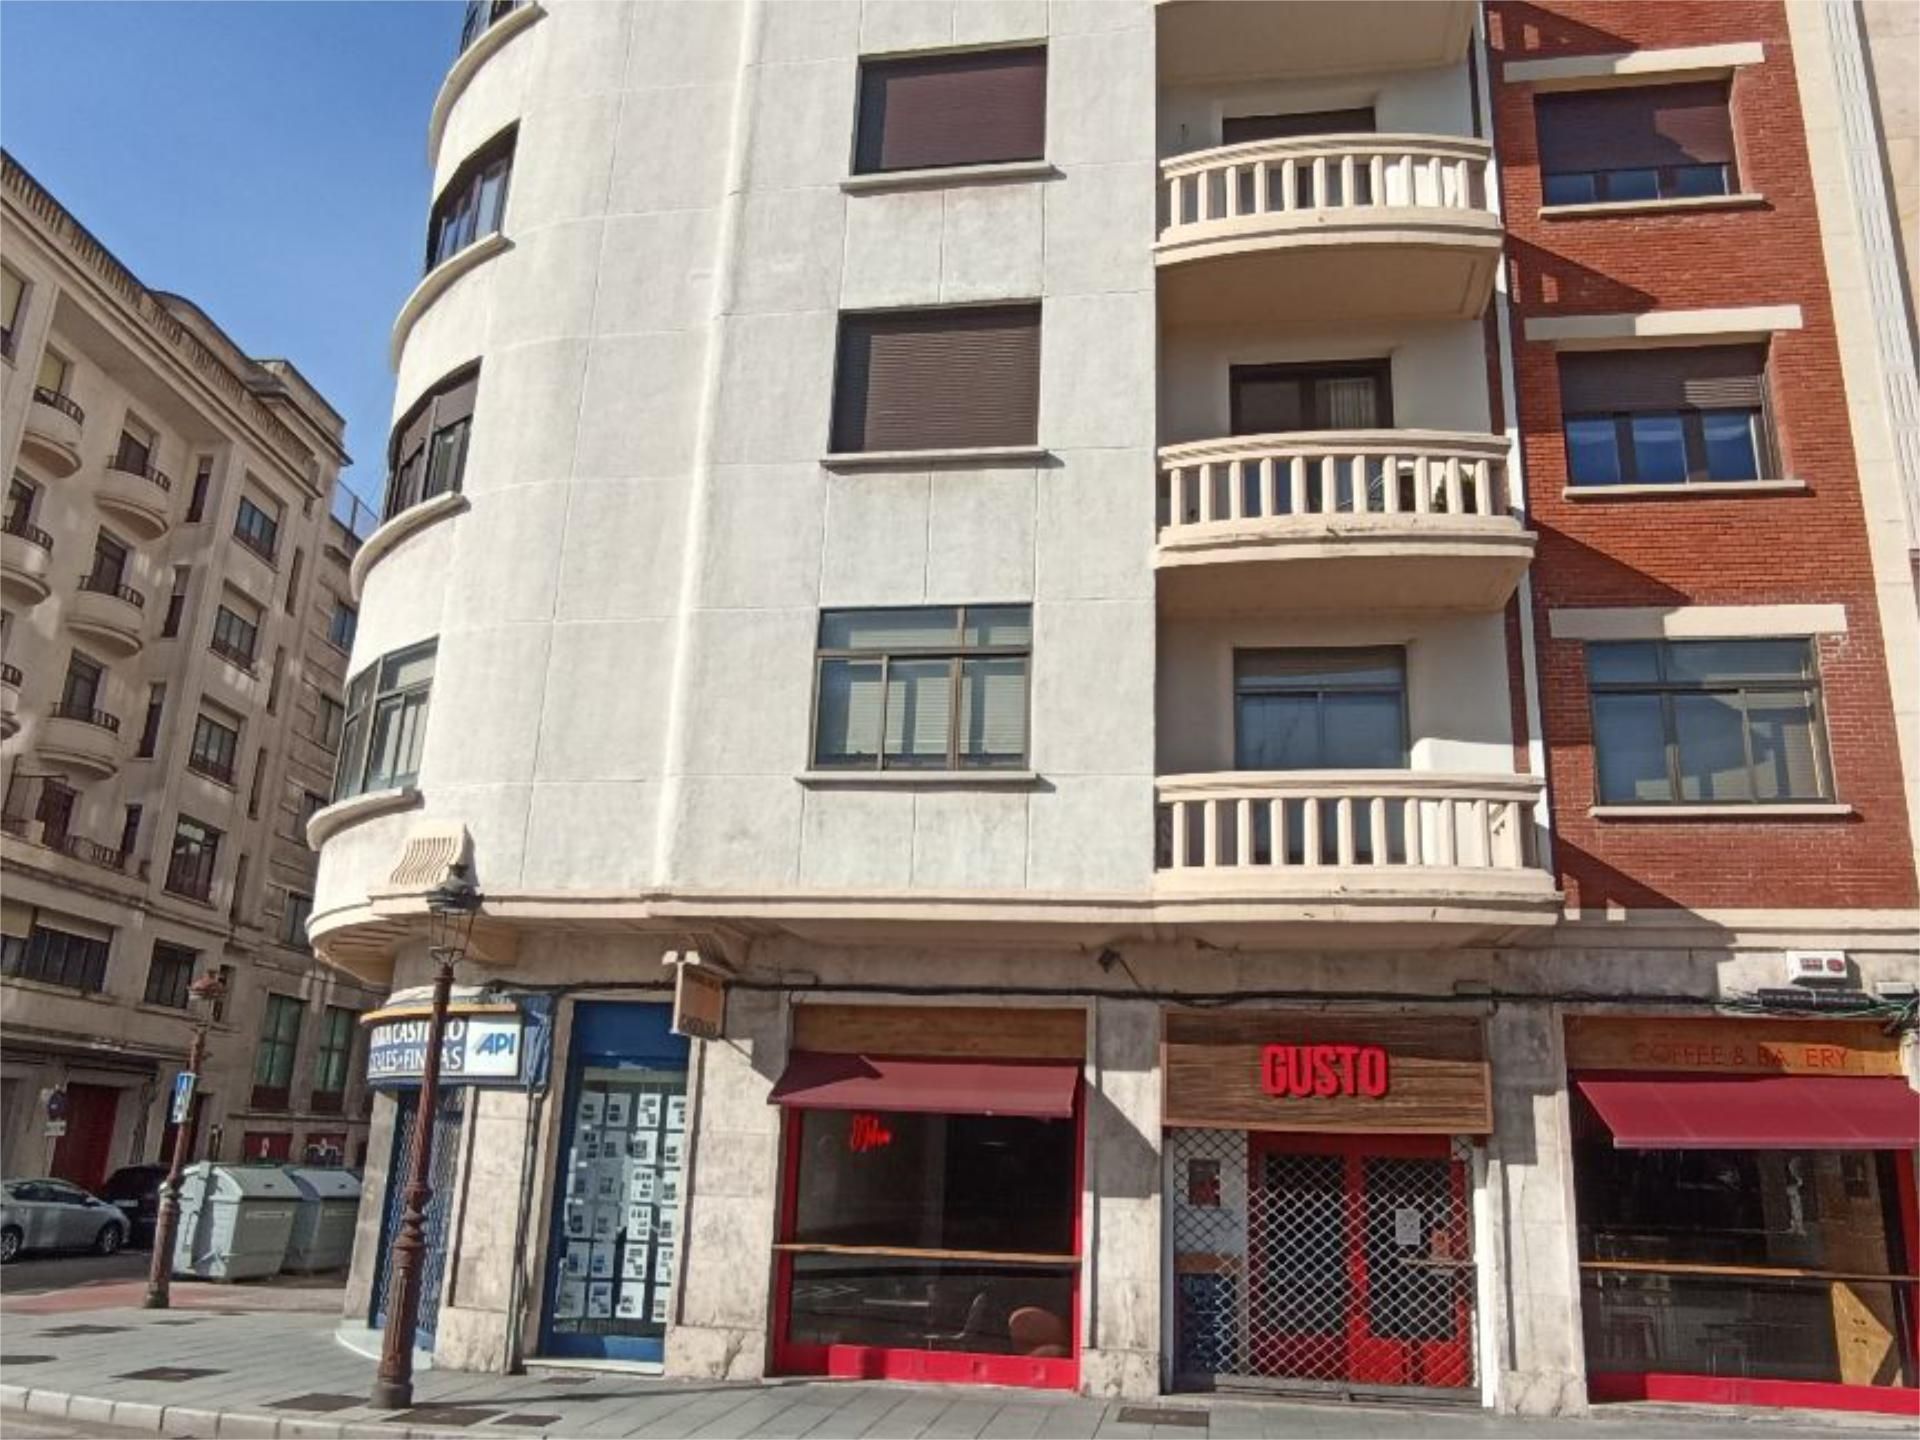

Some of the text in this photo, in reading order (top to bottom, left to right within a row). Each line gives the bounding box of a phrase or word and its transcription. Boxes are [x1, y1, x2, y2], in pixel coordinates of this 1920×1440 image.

[475, 1032, 516, 1055] API
[1632, 1042, 1724, 1065] COFFEE
[1262, 1044, 1388, 1097] GUSTO
